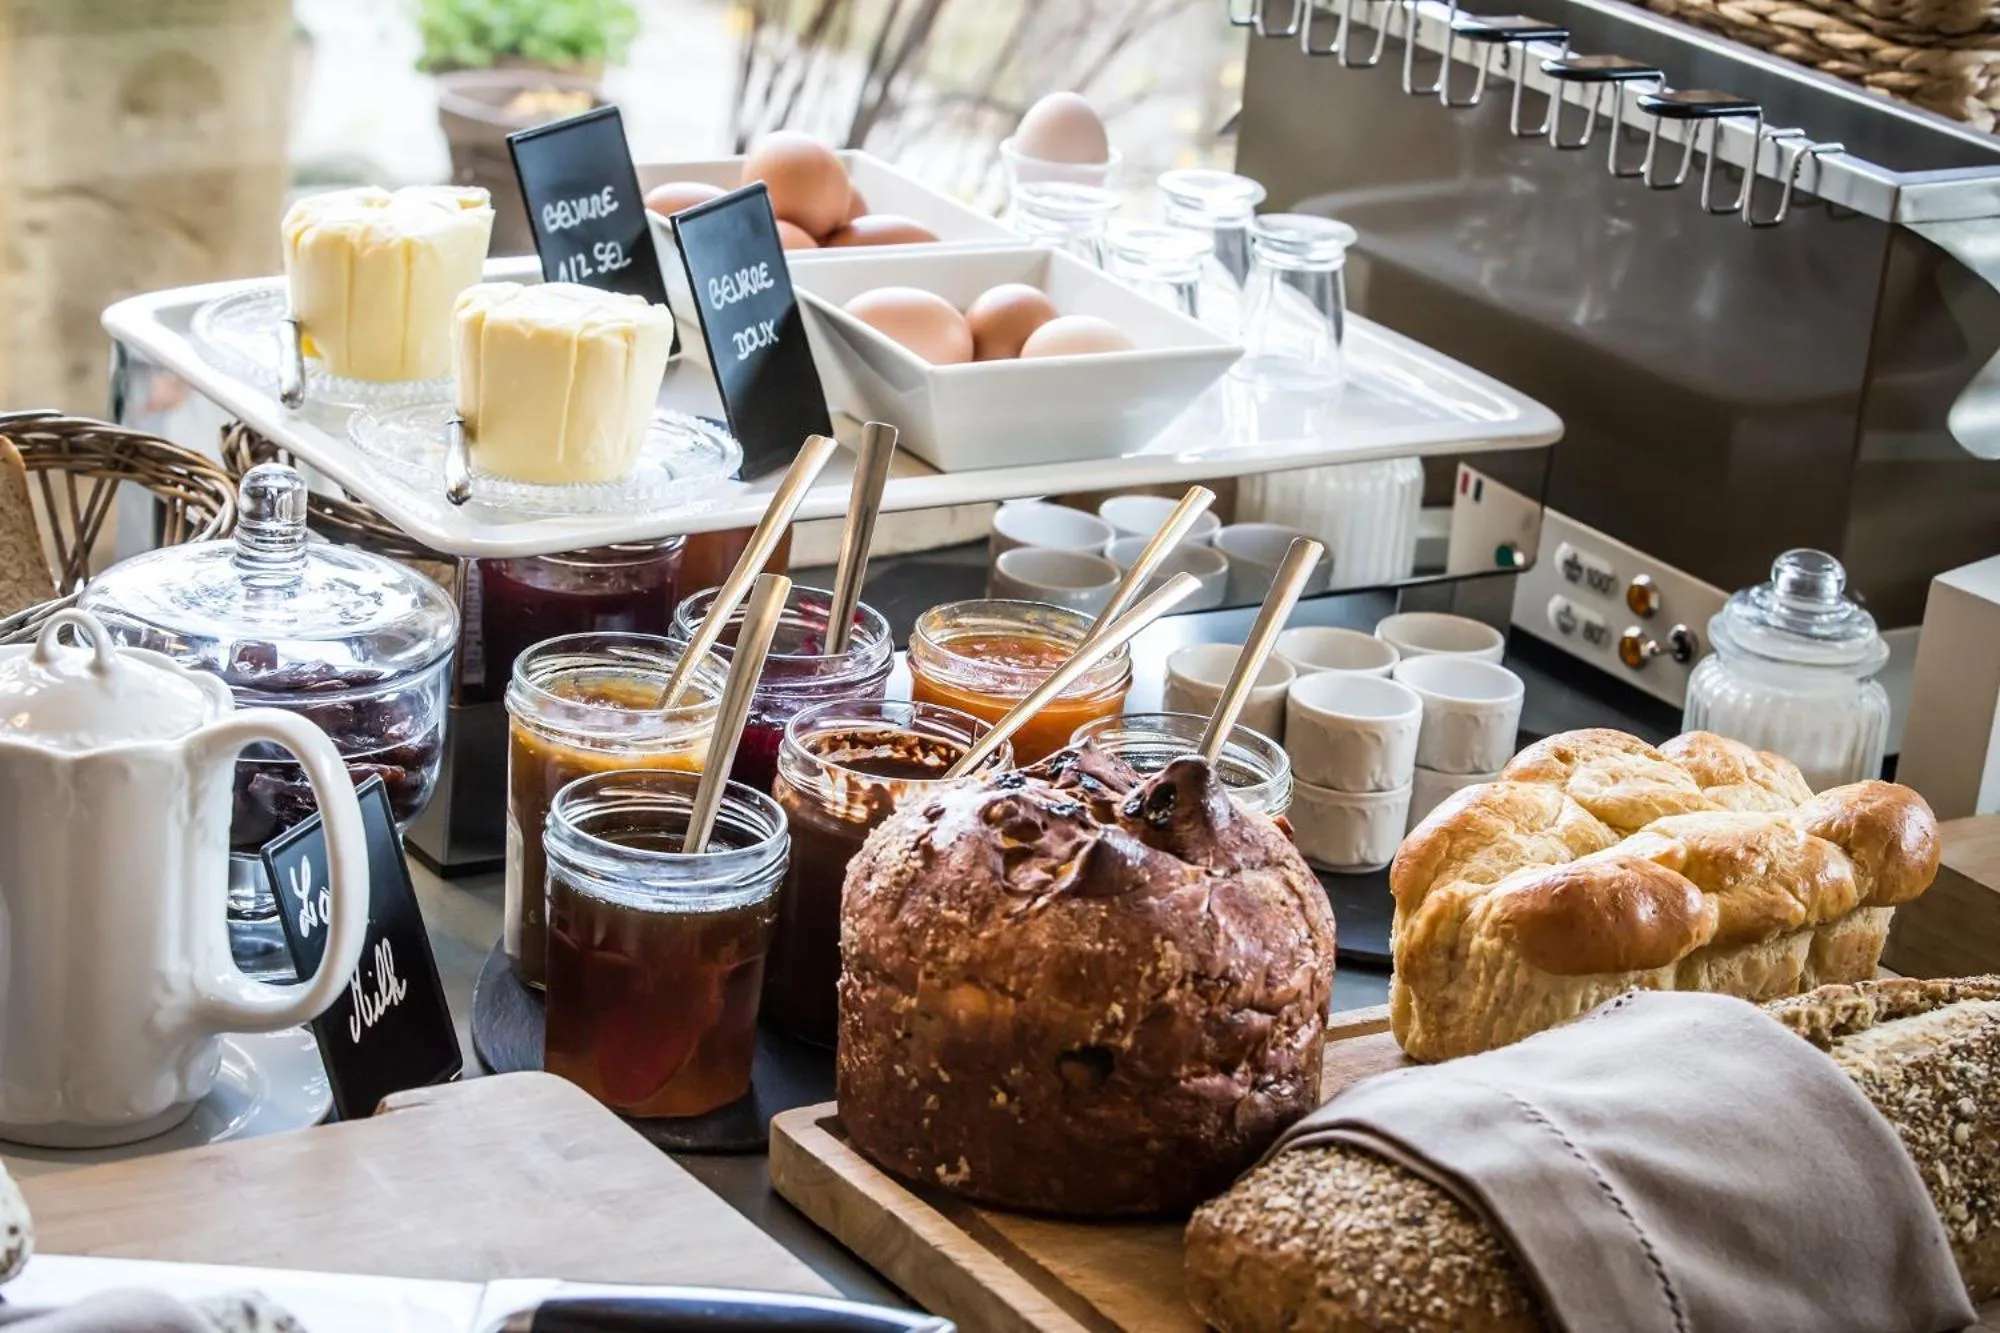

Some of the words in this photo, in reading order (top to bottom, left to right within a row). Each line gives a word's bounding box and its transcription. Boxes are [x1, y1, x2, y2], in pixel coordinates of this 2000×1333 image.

[542, 185, 619, 233] BEURRE
[593, 241, 632, 273] SEL
[708, 261, 774, 310] BEURRE
[732, 319, 779, 360] DOUX
[349, 937, 407, 1043] Milk
